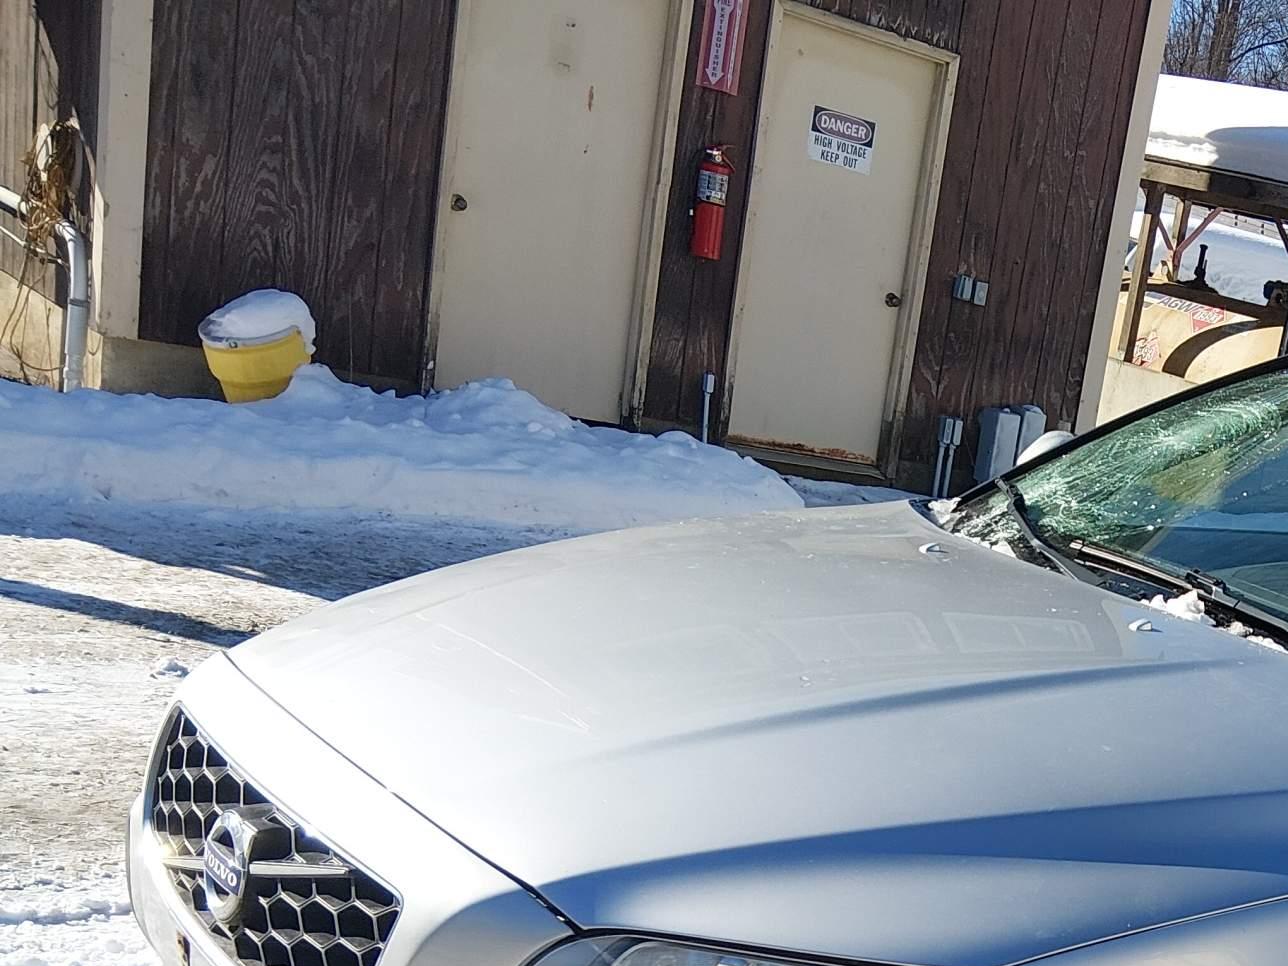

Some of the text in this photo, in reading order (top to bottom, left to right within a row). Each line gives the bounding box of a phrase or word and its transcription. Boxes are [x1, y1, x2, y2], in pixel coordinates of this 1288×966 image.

[711, 6, 726, 78] EXTINGUISHER
[820, 114, 867, 140] DANGER
[814, 133, 868, 160] HIGH VOLTAGE
[820, 149, 858, 169] KEEP OUT
